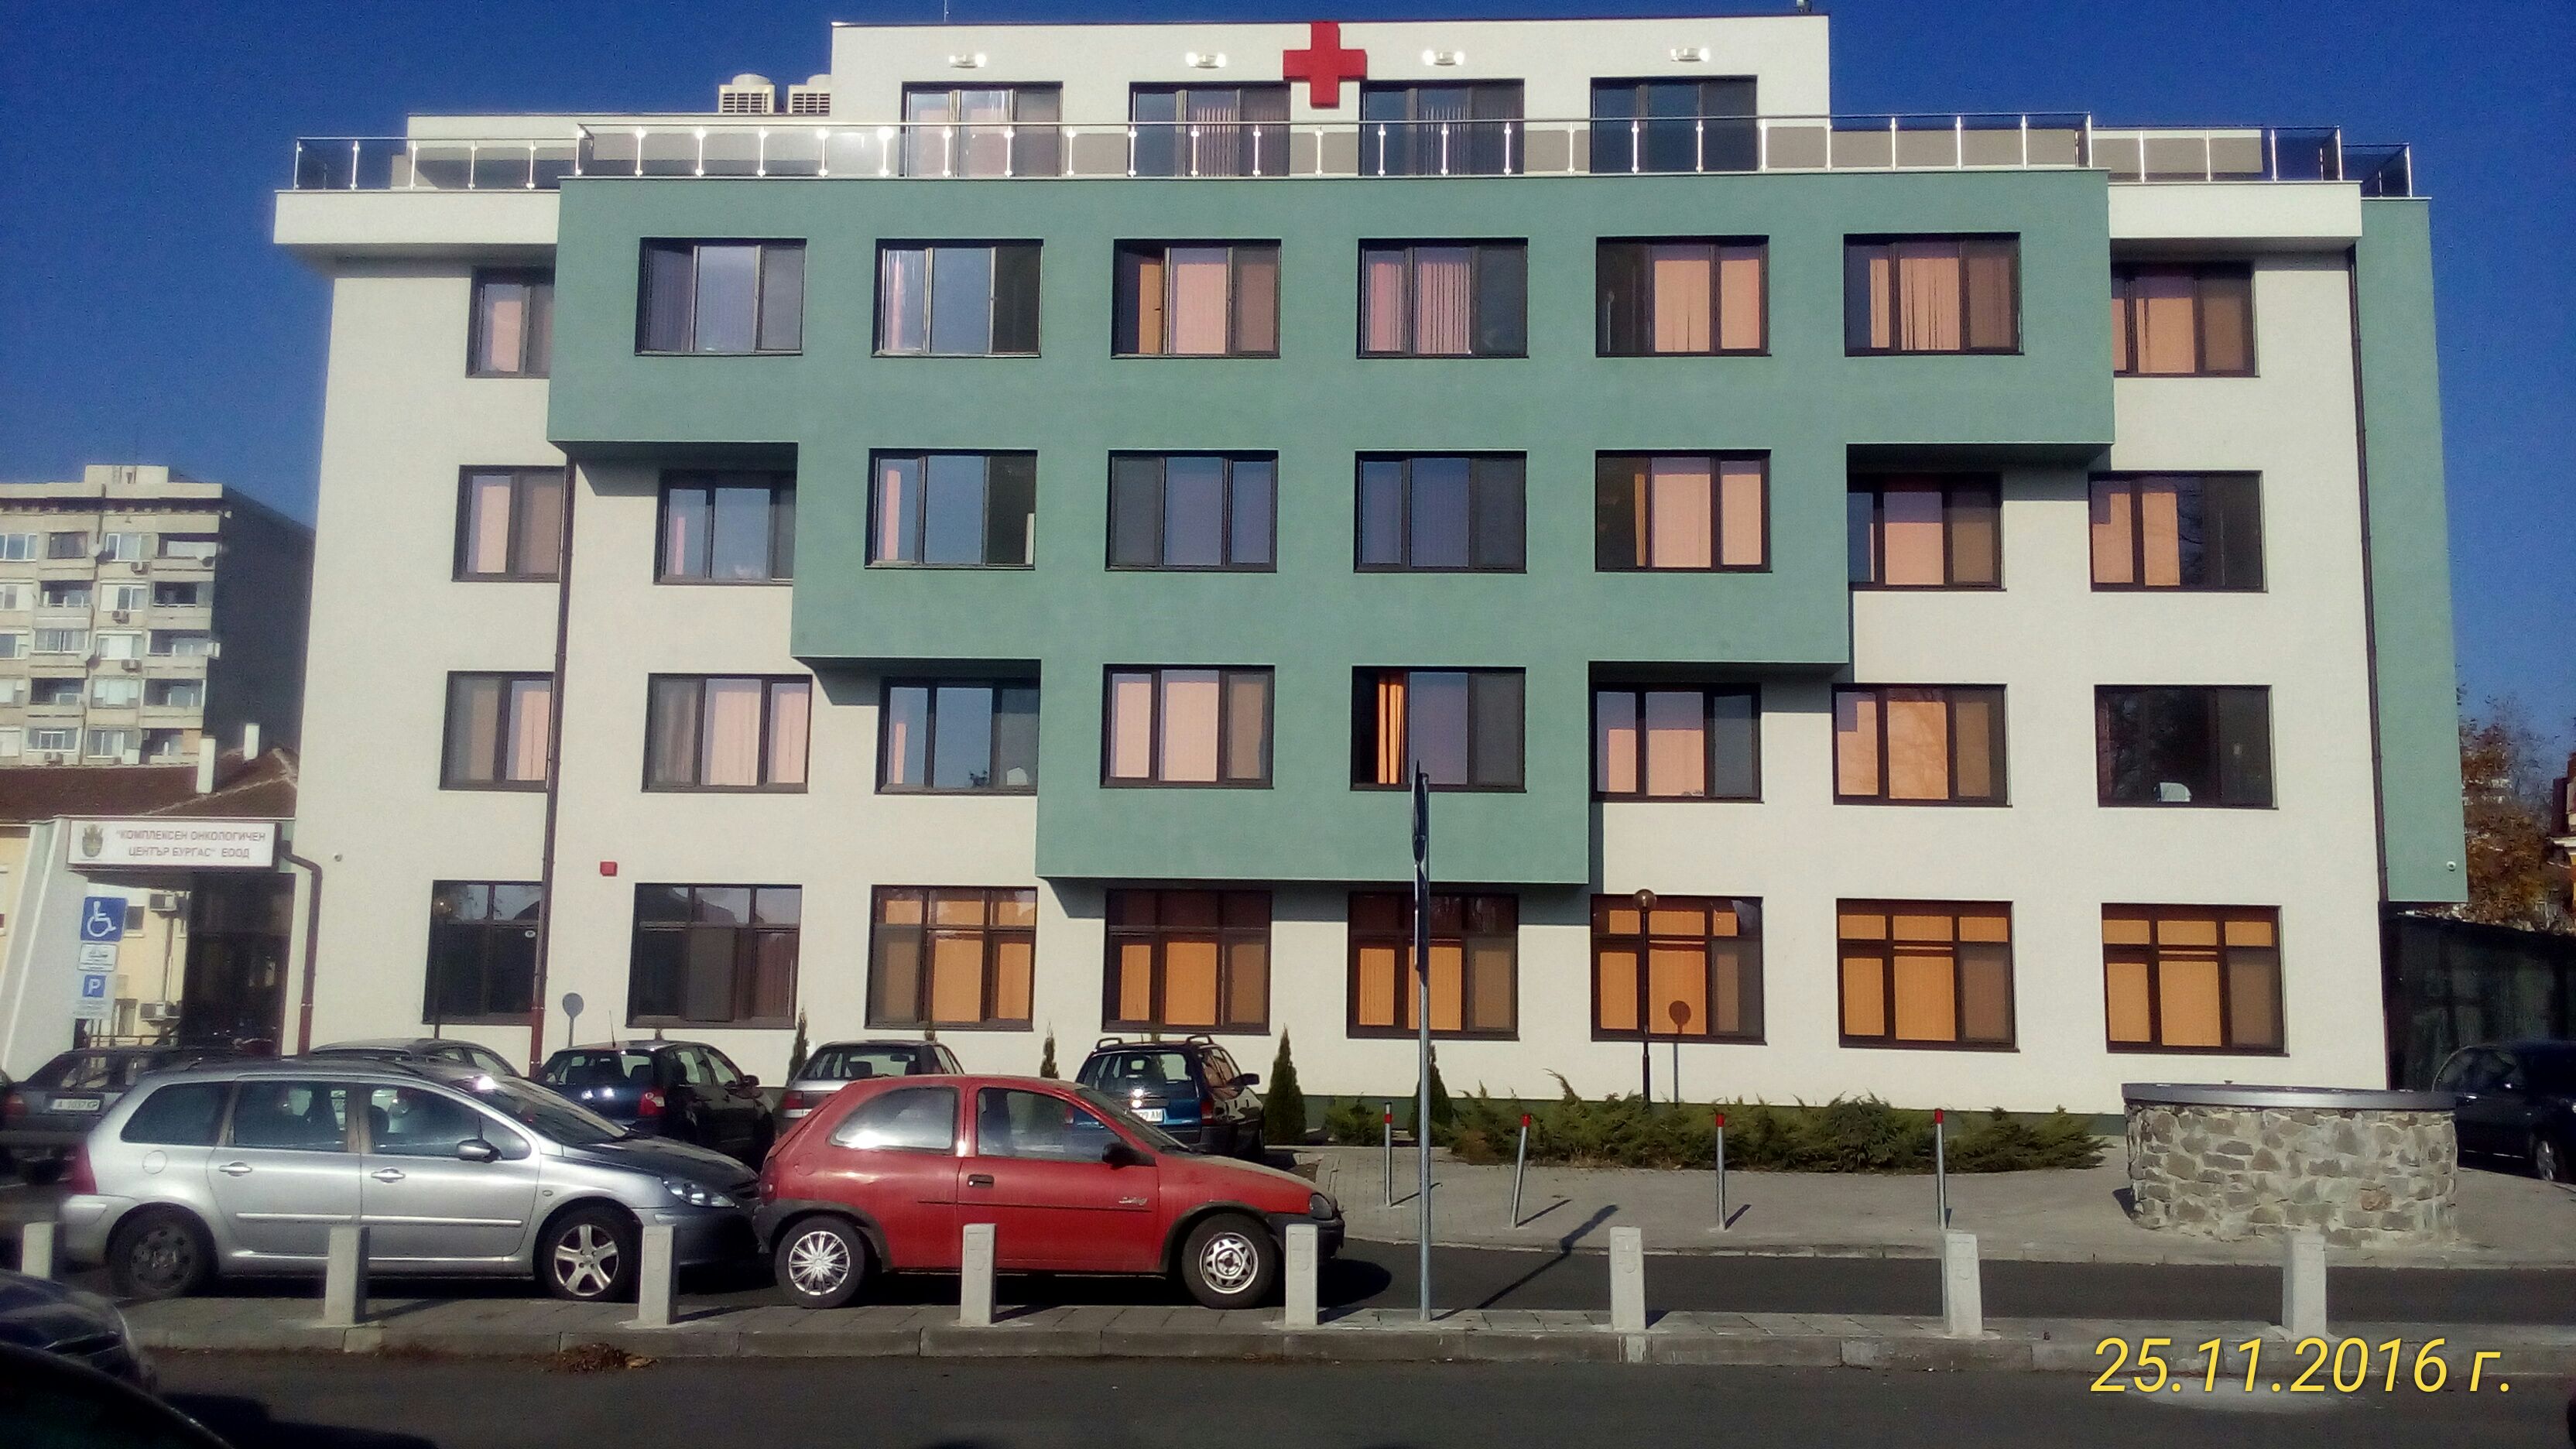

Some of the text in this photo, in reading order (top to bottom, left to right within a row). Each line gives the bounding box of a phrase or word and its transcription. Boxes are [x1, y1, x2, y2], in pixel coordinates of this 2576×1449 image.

[190, 831, 266, 841] ОНКОЛОГИЧЕН
[128, 846, 170, 857] ЦЕНТЪР
[221, 848, 250, 858] ЕООД
[87, 978, 102, 994] P
